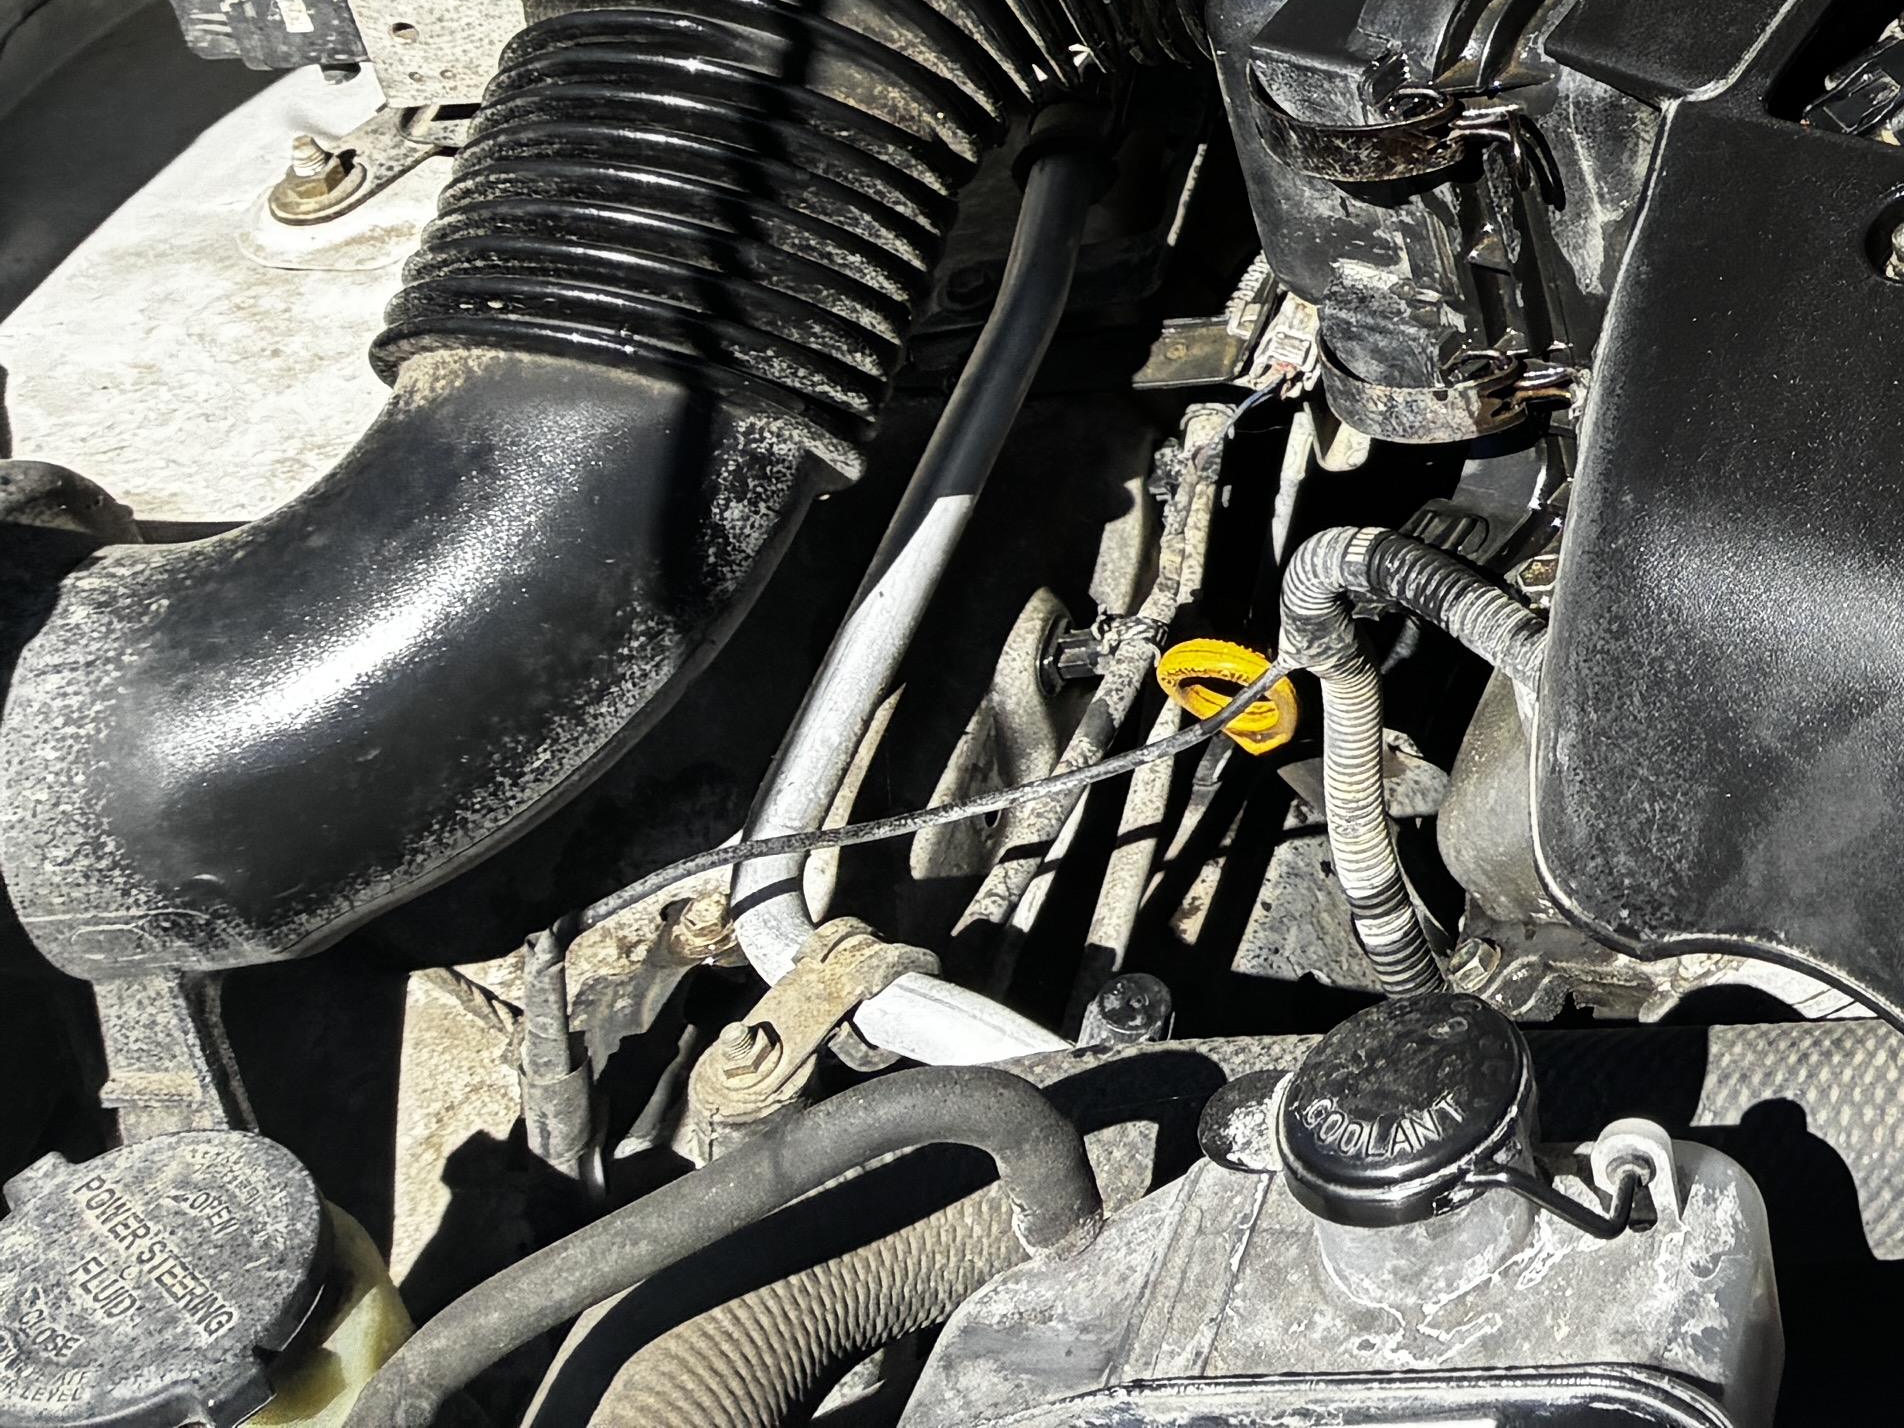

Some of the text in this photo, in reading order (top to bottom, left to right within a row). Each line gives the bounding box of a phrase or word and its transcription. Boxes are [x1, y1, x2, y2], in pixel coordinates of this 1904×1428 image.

[1301, 1090, 1467, 1158] COOLANT
[189, 1191, 239, 1236] OPEN
[67, 1253, 140, 1321] FLUID
[72, 1175, 237, 1340] POWER STEERING
[19, 1309, 82, 1357] CLOSE
